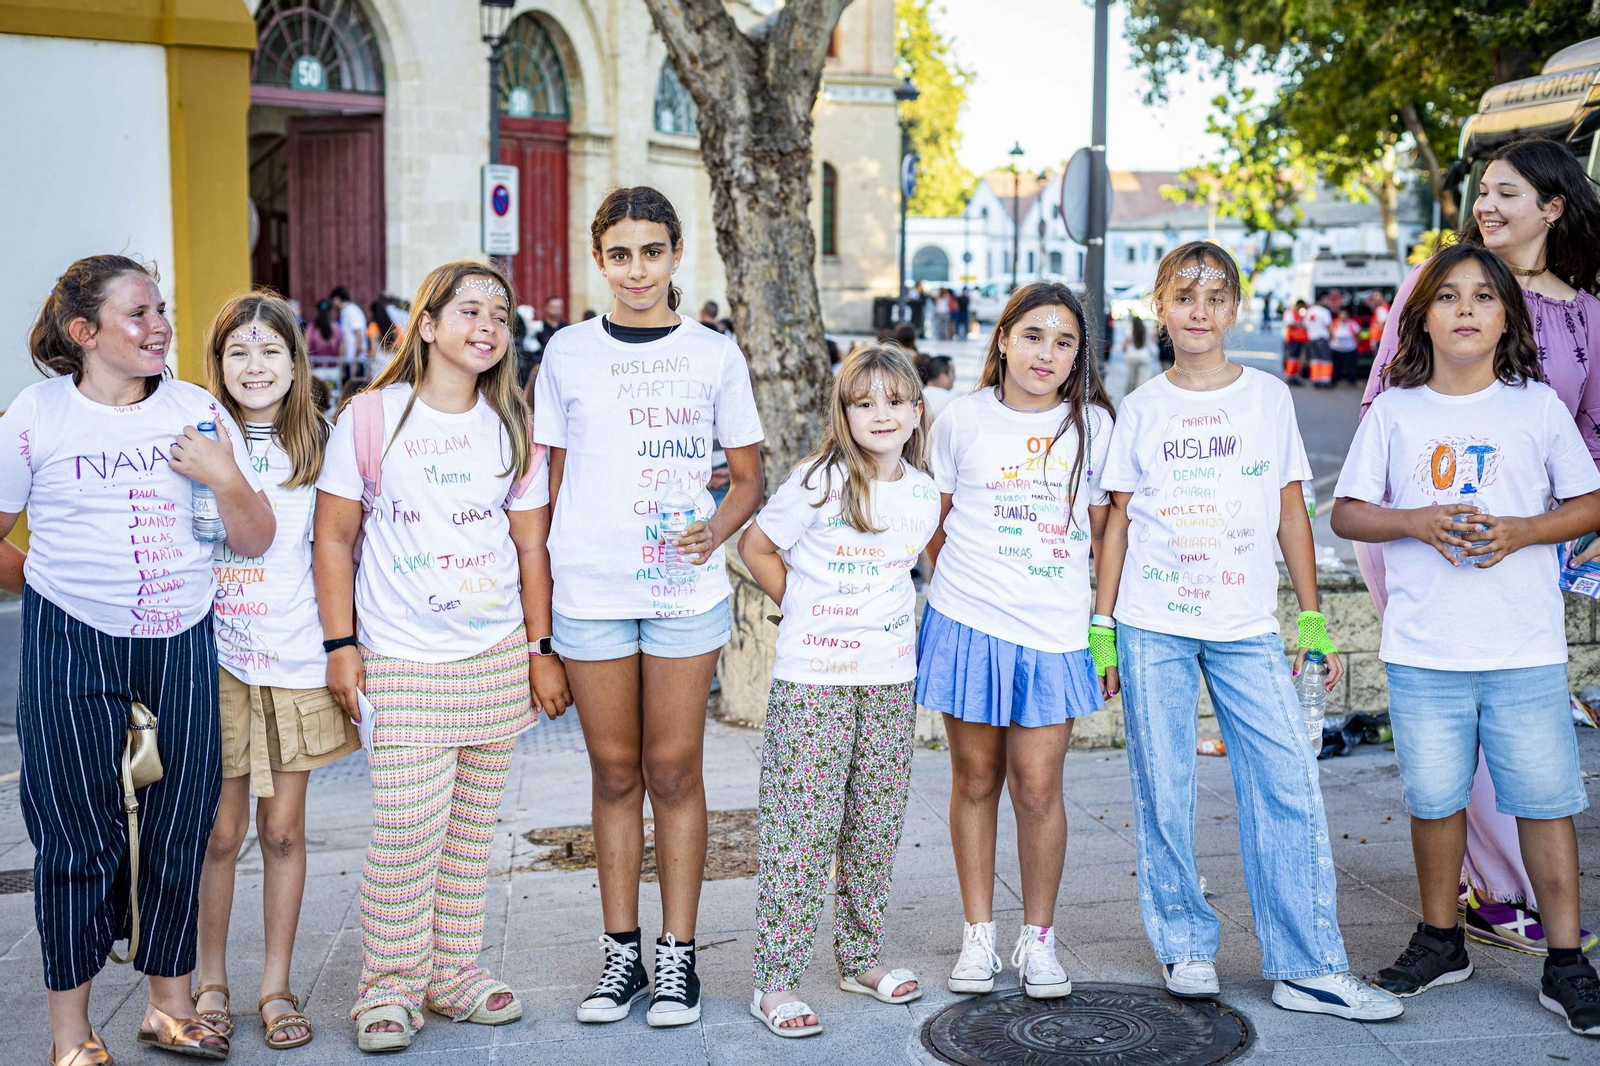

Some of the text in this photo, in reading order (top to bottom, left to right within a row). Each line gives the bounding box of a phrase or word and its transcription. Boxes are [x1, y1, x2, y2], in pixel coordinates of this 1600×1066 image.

[299, 60, 321, 87] 50
[611, 356, 690, 376] RUSLANA
[617, 380, 713, 401] MARTIN
[629, 407, 701, 428] DENNA
[1182, 415, 1222, 429] MARTIN
[404, 434, 473, 458] RUSLANA
[638, 436, 706, 459] JUANJO
[1026, 437, 1055, 455] OT
[1163, 435, 1237, 462] RUSLANA
[1025, 456, 1069, 472] 2024
[1173, 467, 1215, 482] DENNA
[986, 479, 1031, 490] NAIARA
[129, 488, 158, 499] PAUL
[994, 504, 1037, 522] JUANJO
[1160, 504, 1215, 517] VIOLETA
[1175, 517, 1225, 528] JUANJO
[131, 532, 174, 545] LUCAS
[998, 525, 1023, 537] OMAR
[1171, 528, 1255, 549] NAIARA ALVARO
[836, 545, 886, 558] ALVARO
[998, 545, 1071, 560] LUKAS BEA
[1180, 542, 1255, 563] PAUL MAYO
[1028, 565, 1064, 579] SUSETE
[1142, 564, 1245, 585] SALMA ALEX BEA
[137, 578, 185, 596] ALVARO
[216, 583, 244, 599] BEA
[459, 577, 498, 594] ALEX
[838, 581, 871, 594] BEA
[1178, 586, 1212, 601] OMAR
[653, 600, 685, 609] PAUL
[1167, 602, 1202, 617] CHRIS
[803, 633, 861, 649] JUANJO
[810, 658, 858, 675] OMAR
